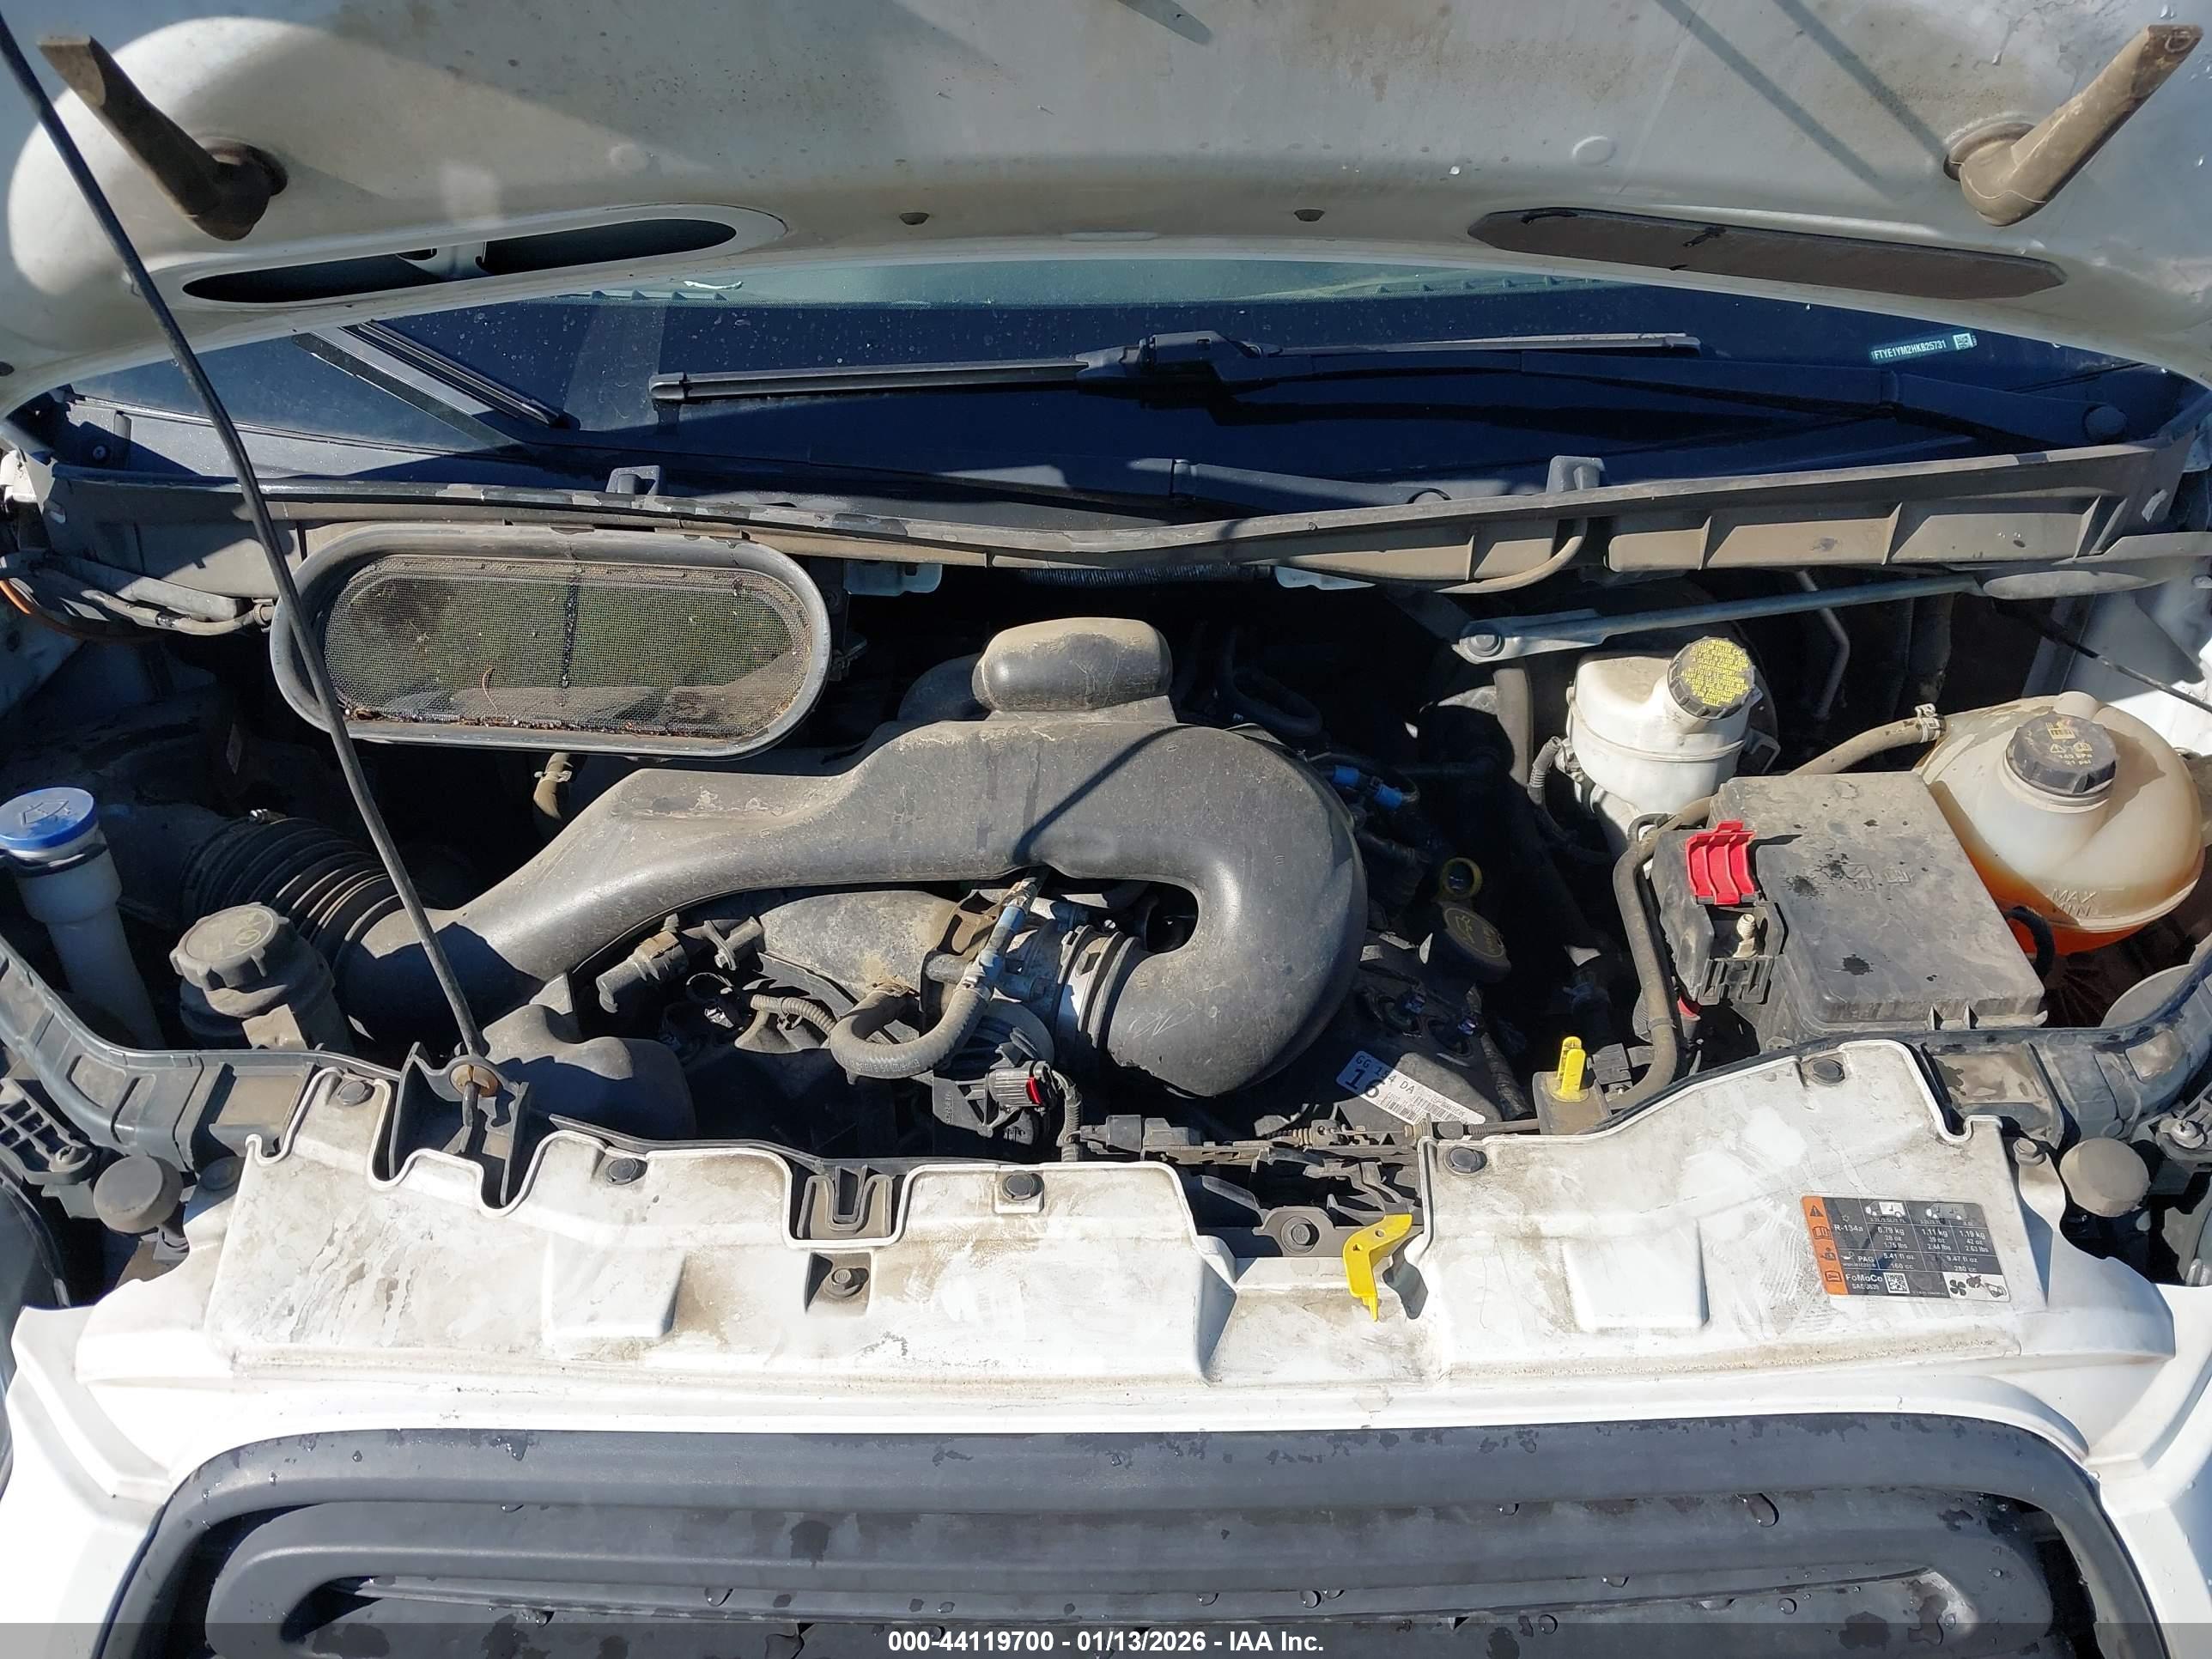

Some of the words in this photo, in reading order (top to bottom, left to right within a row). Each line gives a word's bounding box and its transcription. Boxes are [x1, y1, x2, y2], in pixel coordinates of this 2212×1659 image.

[2052, 888, 2097, 904] MAX
[1357, 1055, 1371, 1068] GG
[1400, 1080, 1415, 1093] DA
[1346, 1069, 1385, 1098] 16
[1833, 1224, 1863, 1232] R-134a
[1894, 1227, 1905, 1236] kg
[1937, 1229, 1948, 1237] kg
[1975, 1231, 1985, 1240] kg
[1846, 1273, 1882, 1282] FoMoCo
